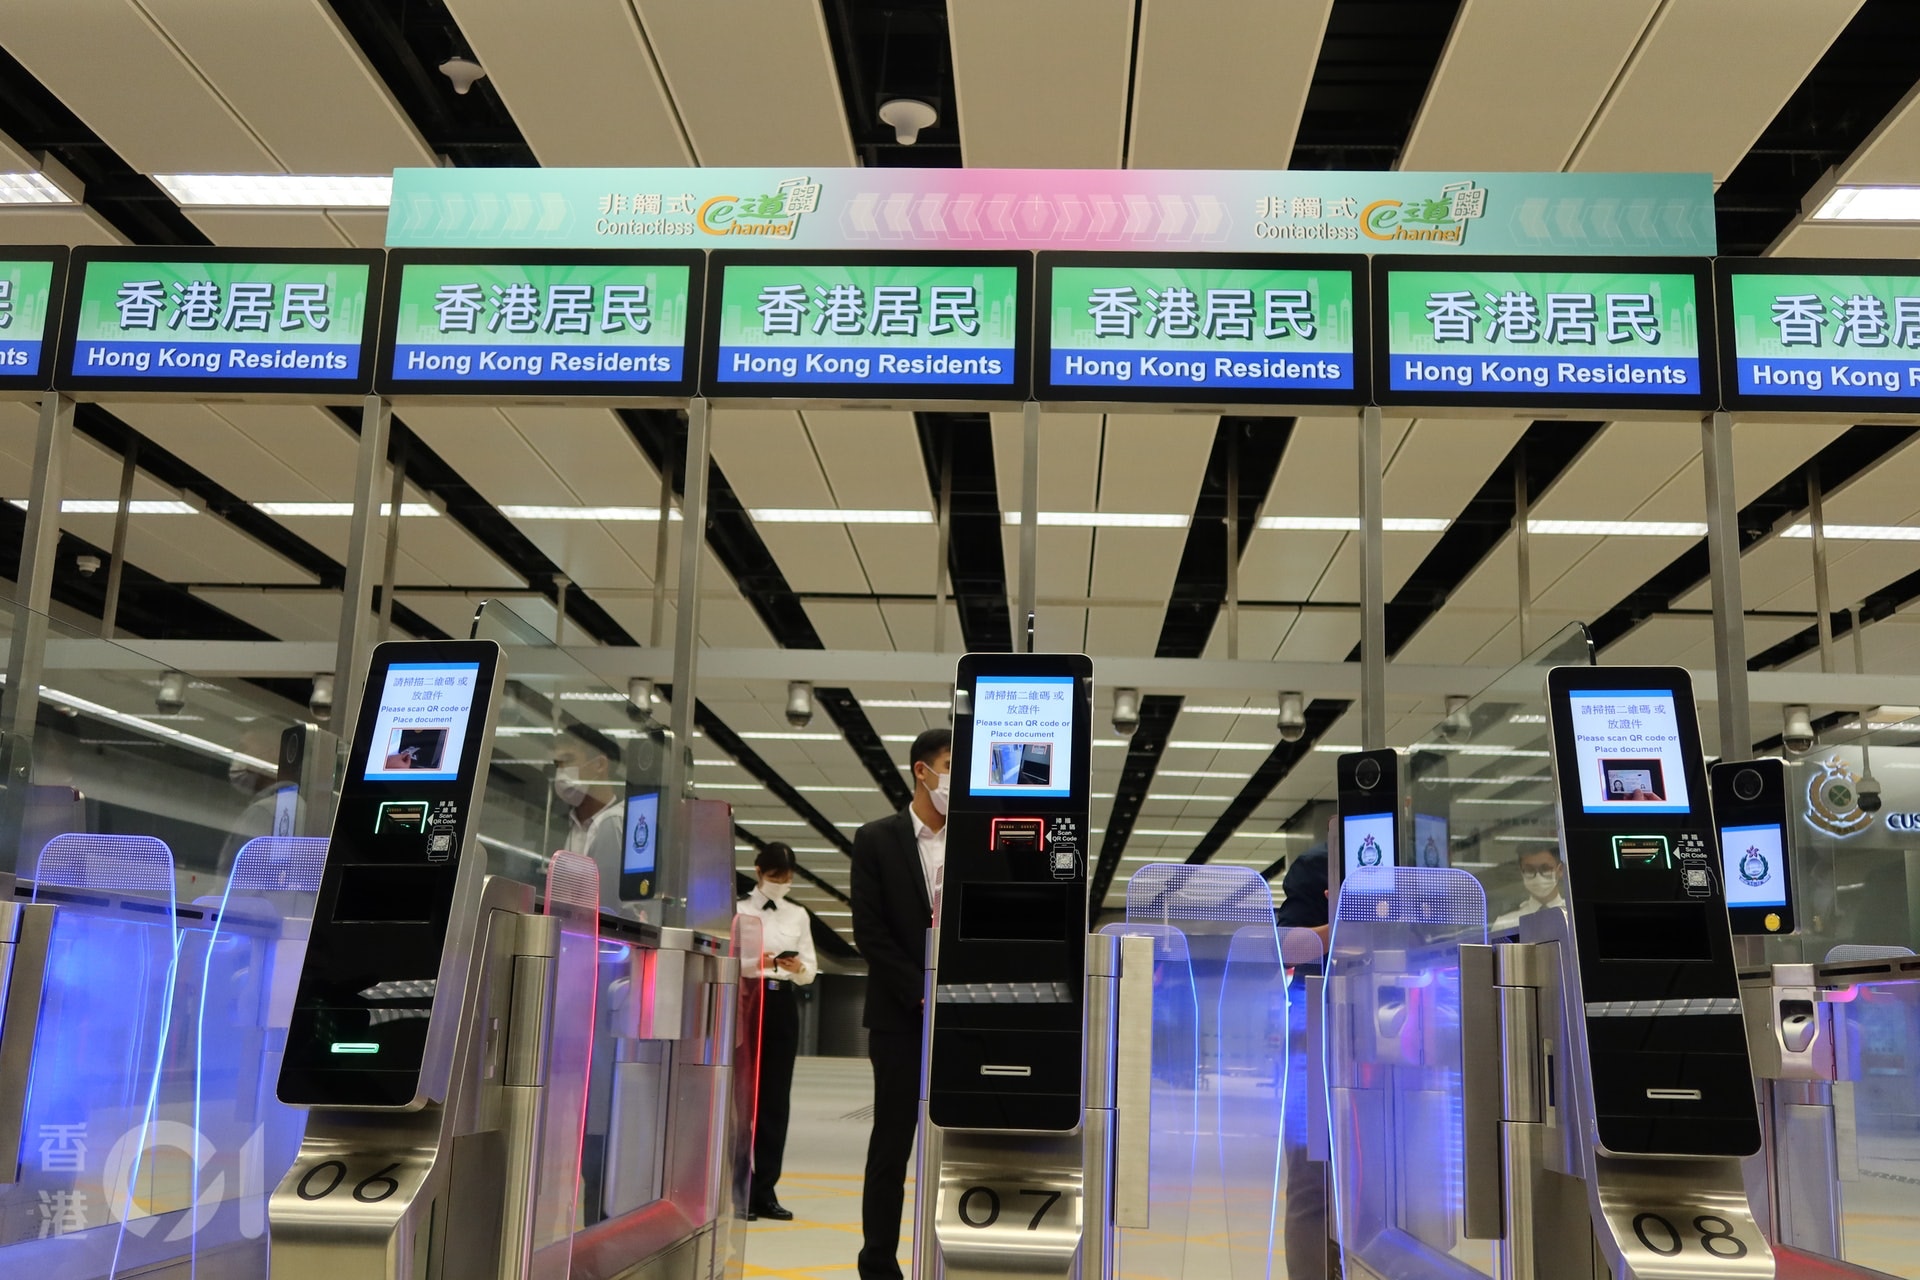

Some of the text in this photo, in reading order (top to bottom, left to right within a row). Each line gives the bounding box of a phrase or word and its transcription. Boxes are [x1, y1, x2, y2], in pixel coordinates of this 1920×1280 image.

[597, 193, 697, 215] 非觸式
[1255, 196, 1359, 219] 非觸式
[596, 218, 695, 235] Contactless
[1255, 221, 1359, 240] Contactless
[115, 280, 330, 332] 香港居民
[433, 283, 651, 334] 香港居民
[756, 284, 980, 336] 香港居民
[1087, 286, 1317, 340] 香港居民
[1424, 290, 1660, 345] 香港居民
[88, 347, 349, 372] Hong Kong Residents
[408, 351, 671, 375] Hong Kong Residents
[733, 353, 1002, 378] Hong Kong Residents
[1065, 355, 1342, 382] Hong Kong Residents
[1404, 361, 1688, 387] Hong Kong Residents
[1753, 365, 1823, 390] Hong
[1831, 366, 1901, 392] Kong
[393, 677, 468, 687] 請掃描二維碼 或
[411, 691, 444, 701] 放證件
[984, 690, 1065, 701] 請掃描二維碼 或
[381, 705, 405, 713] Please
[426, 705, 439, 713] QR
[440, 705, 459, 713] code
[1006, 704, 1040, 716] 放證件
[1581, 704, 1666, 715] 請掃描二維碼 或
[976, 719, 1002, 727] Please
[1025, 719, 1038, 728] QR
[1039, 719, 1059, 727] code
[990, 730, 1054, 738] Place document
[1607, 719, 1643, 730] 放證件
[1577, 734, 1605, 742] Please
[1630, 734, 1643, 743] QR
[1645, 734, 1666, 742] code
[296, 1160, 402, 1202] 06
[958, 1186, 1062, 1231] 07
[1632, 1212, 1748, 1260] 08
